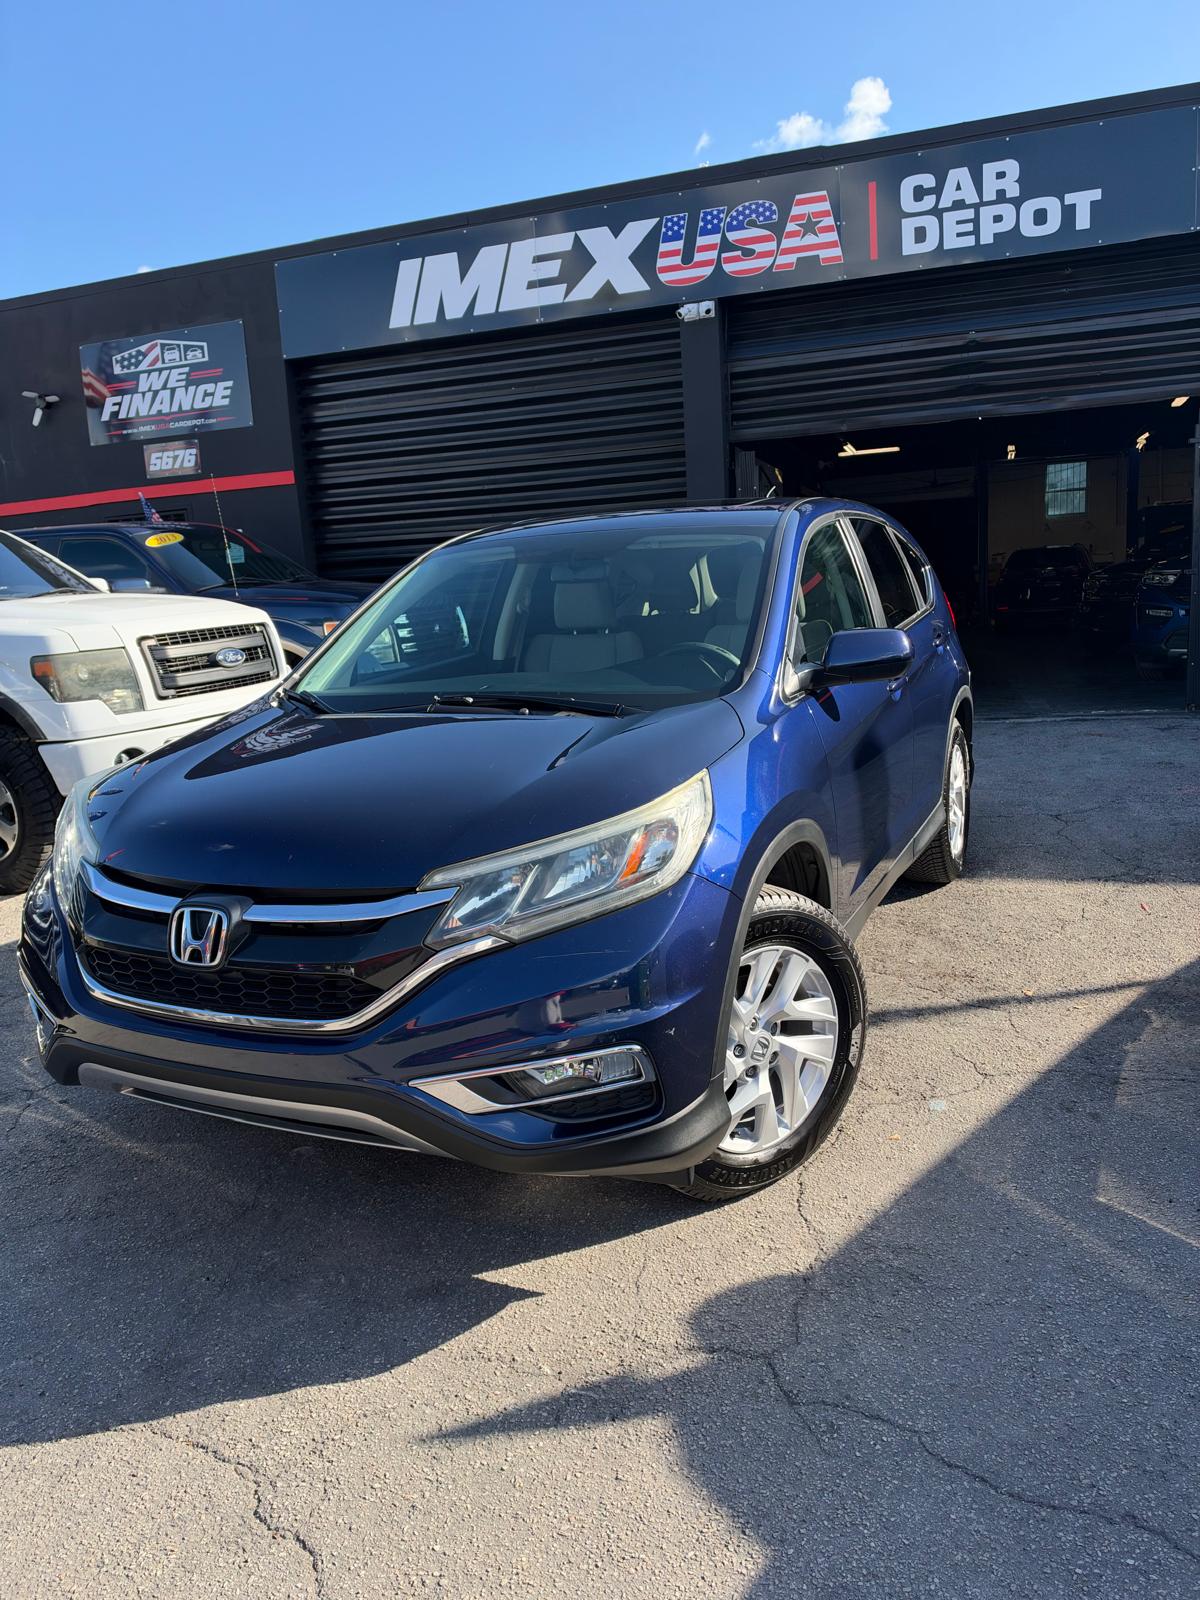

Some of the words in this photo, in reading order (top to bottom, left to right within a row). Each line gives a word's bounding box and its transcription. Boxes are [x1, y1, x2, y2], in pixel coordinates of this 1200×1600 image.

[900, 158, 1020, 213] CAR
[901, 188, 1102, 256] DEPOT
[138, 366, 190, 393] WE
[100, 380, 234, 422] FINANCE
[149, 448, 197, 472] 5676
